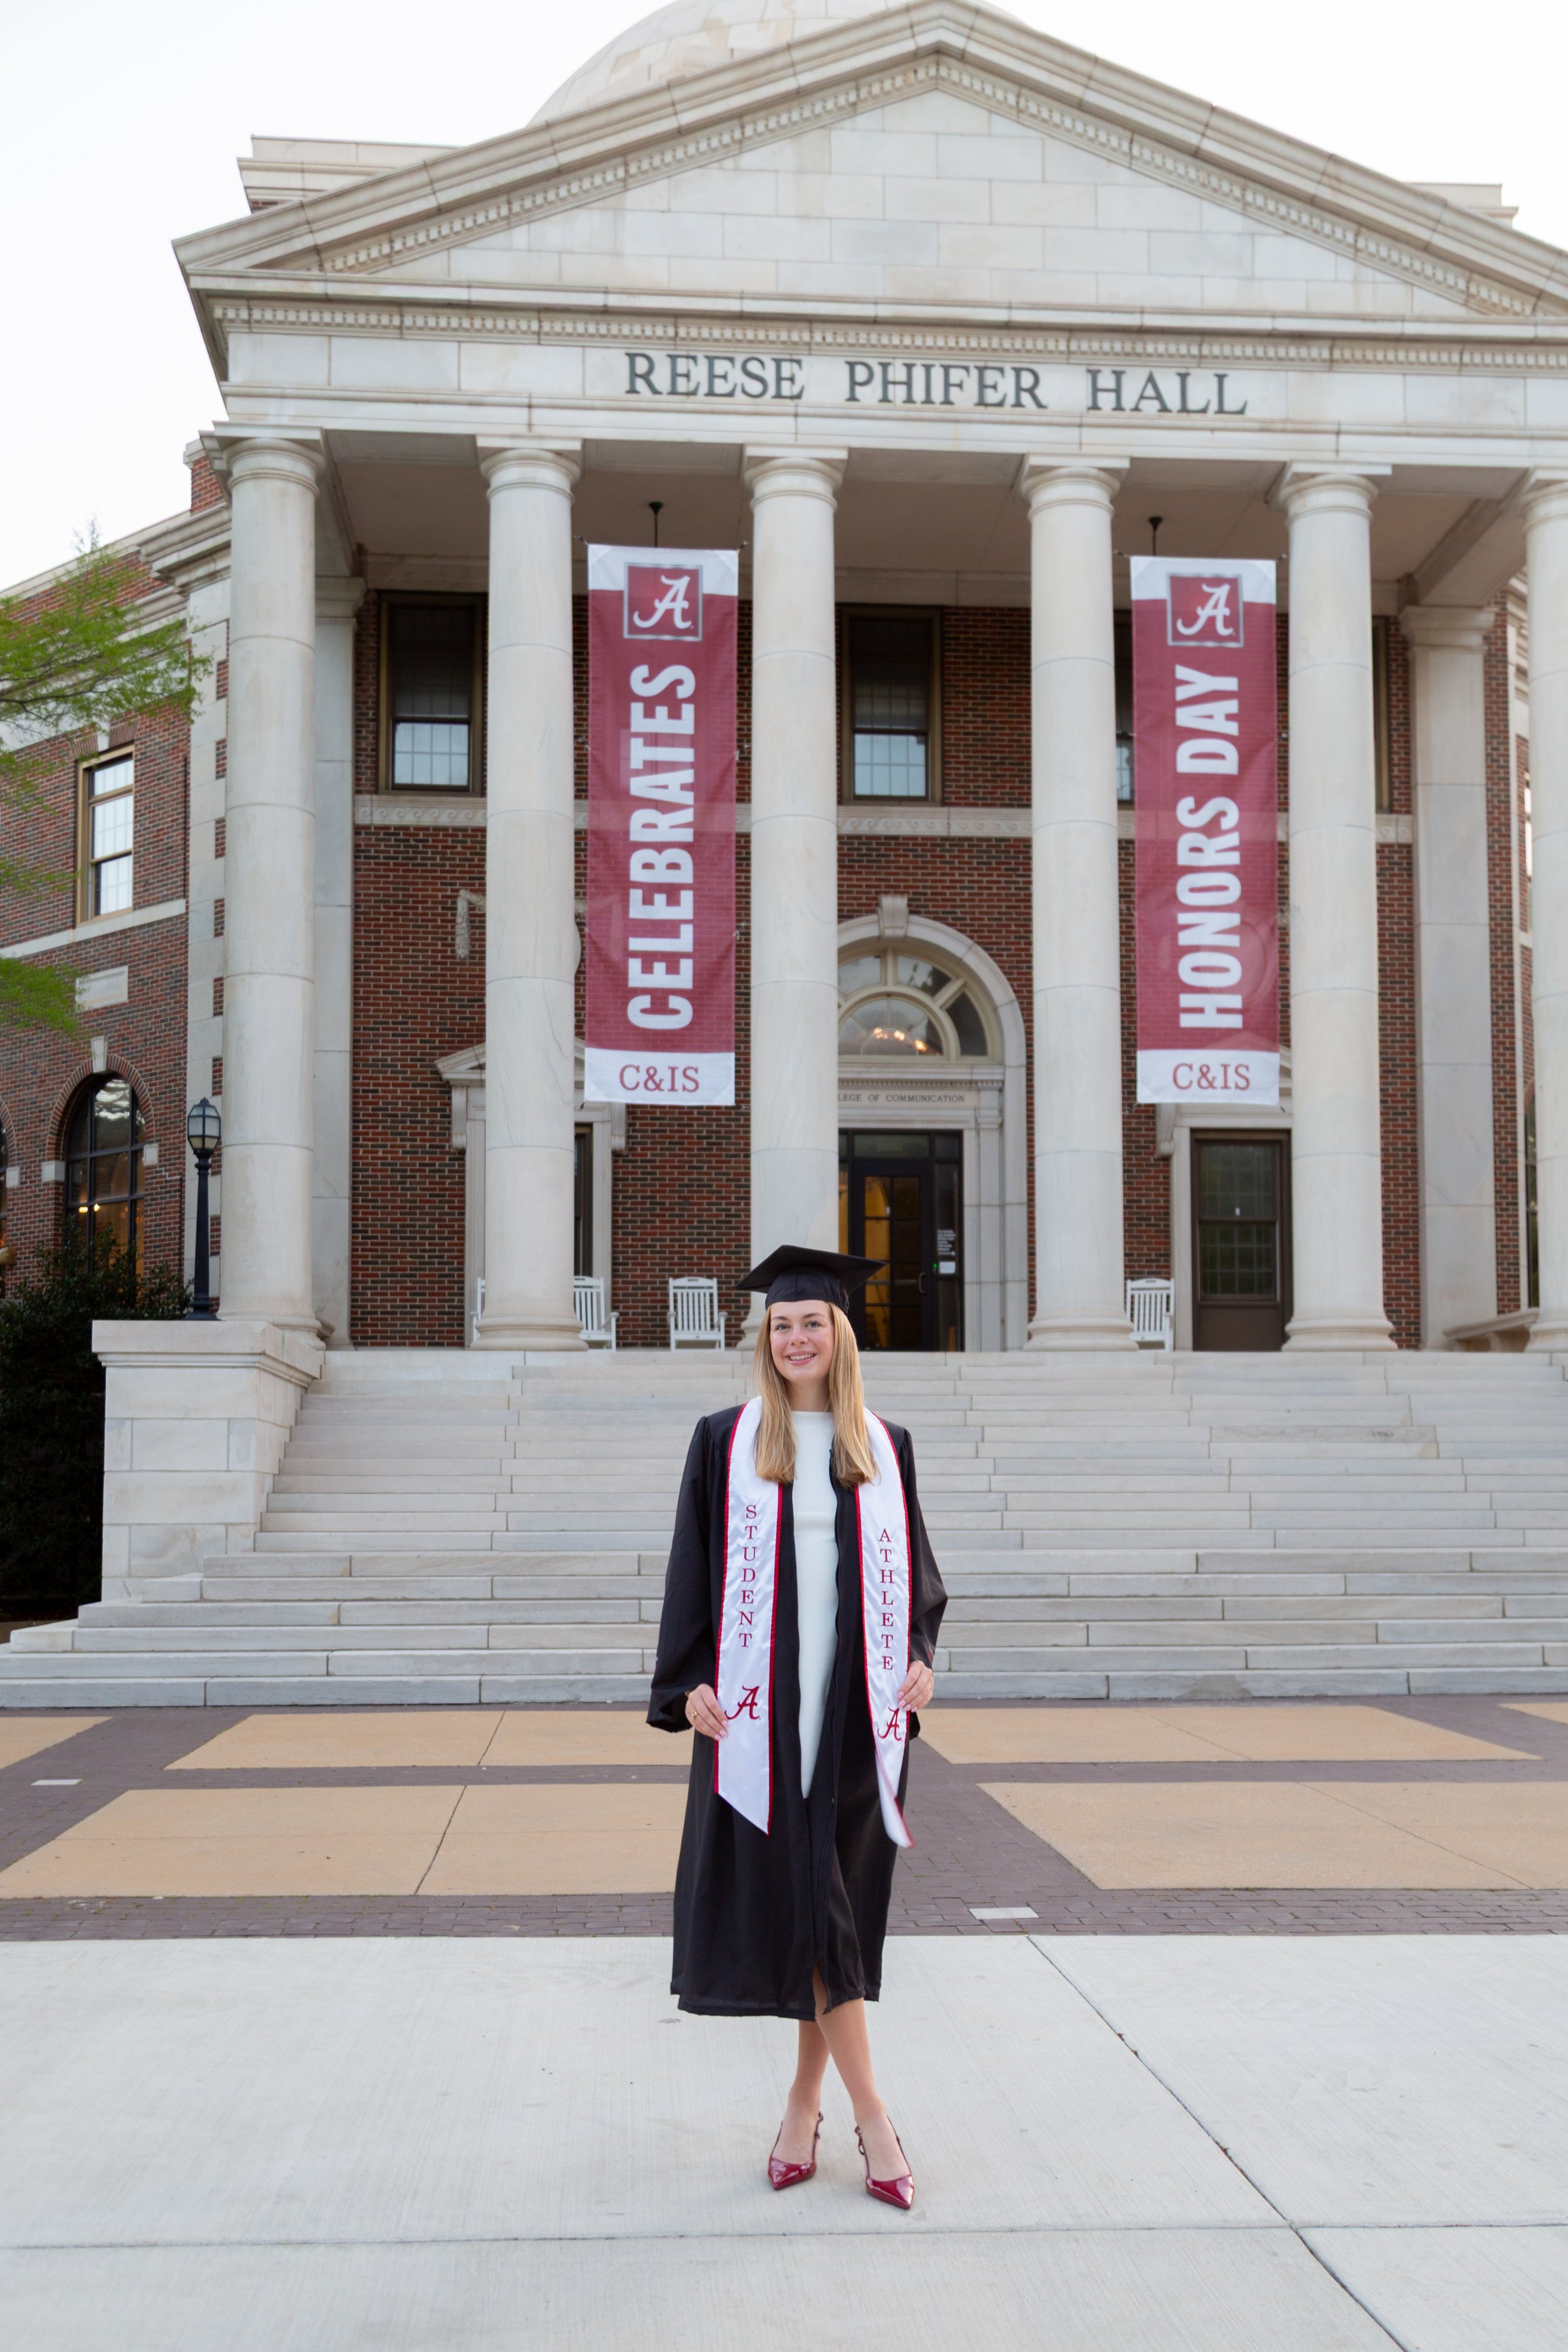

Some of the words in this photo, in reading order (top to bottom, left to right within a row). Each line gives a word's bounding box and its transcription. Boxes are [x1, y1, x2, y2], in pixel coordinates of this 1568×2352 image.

[624, 352, 805, 400] REESE
[844, 360, 1047, 410] PHIFER
[1086, 368, 1248, 415] HALL
[633, 575, 691, 629] A
[1175, 583, 1234, 636] A
[1175, 664, 1239, 775] DAY
[627, 664, 696, 1030] CELEBRATES
[1175, 795, 1244, 1029] HONORS
[619, 1064, 700, 1093] C&IS
[867, 1094, 881, 1102] OF
[886, 1094, 965, 1103] COMMUNICATION
[1172, 1062, 1251, 1091] C&IS
[738, 1504, 757, 1648] STUDENT
[879, 1527, 894, 1671] ATHLETE
[724, 1685, 760, 1720] A
[877, 1706, 902, 1741] A
